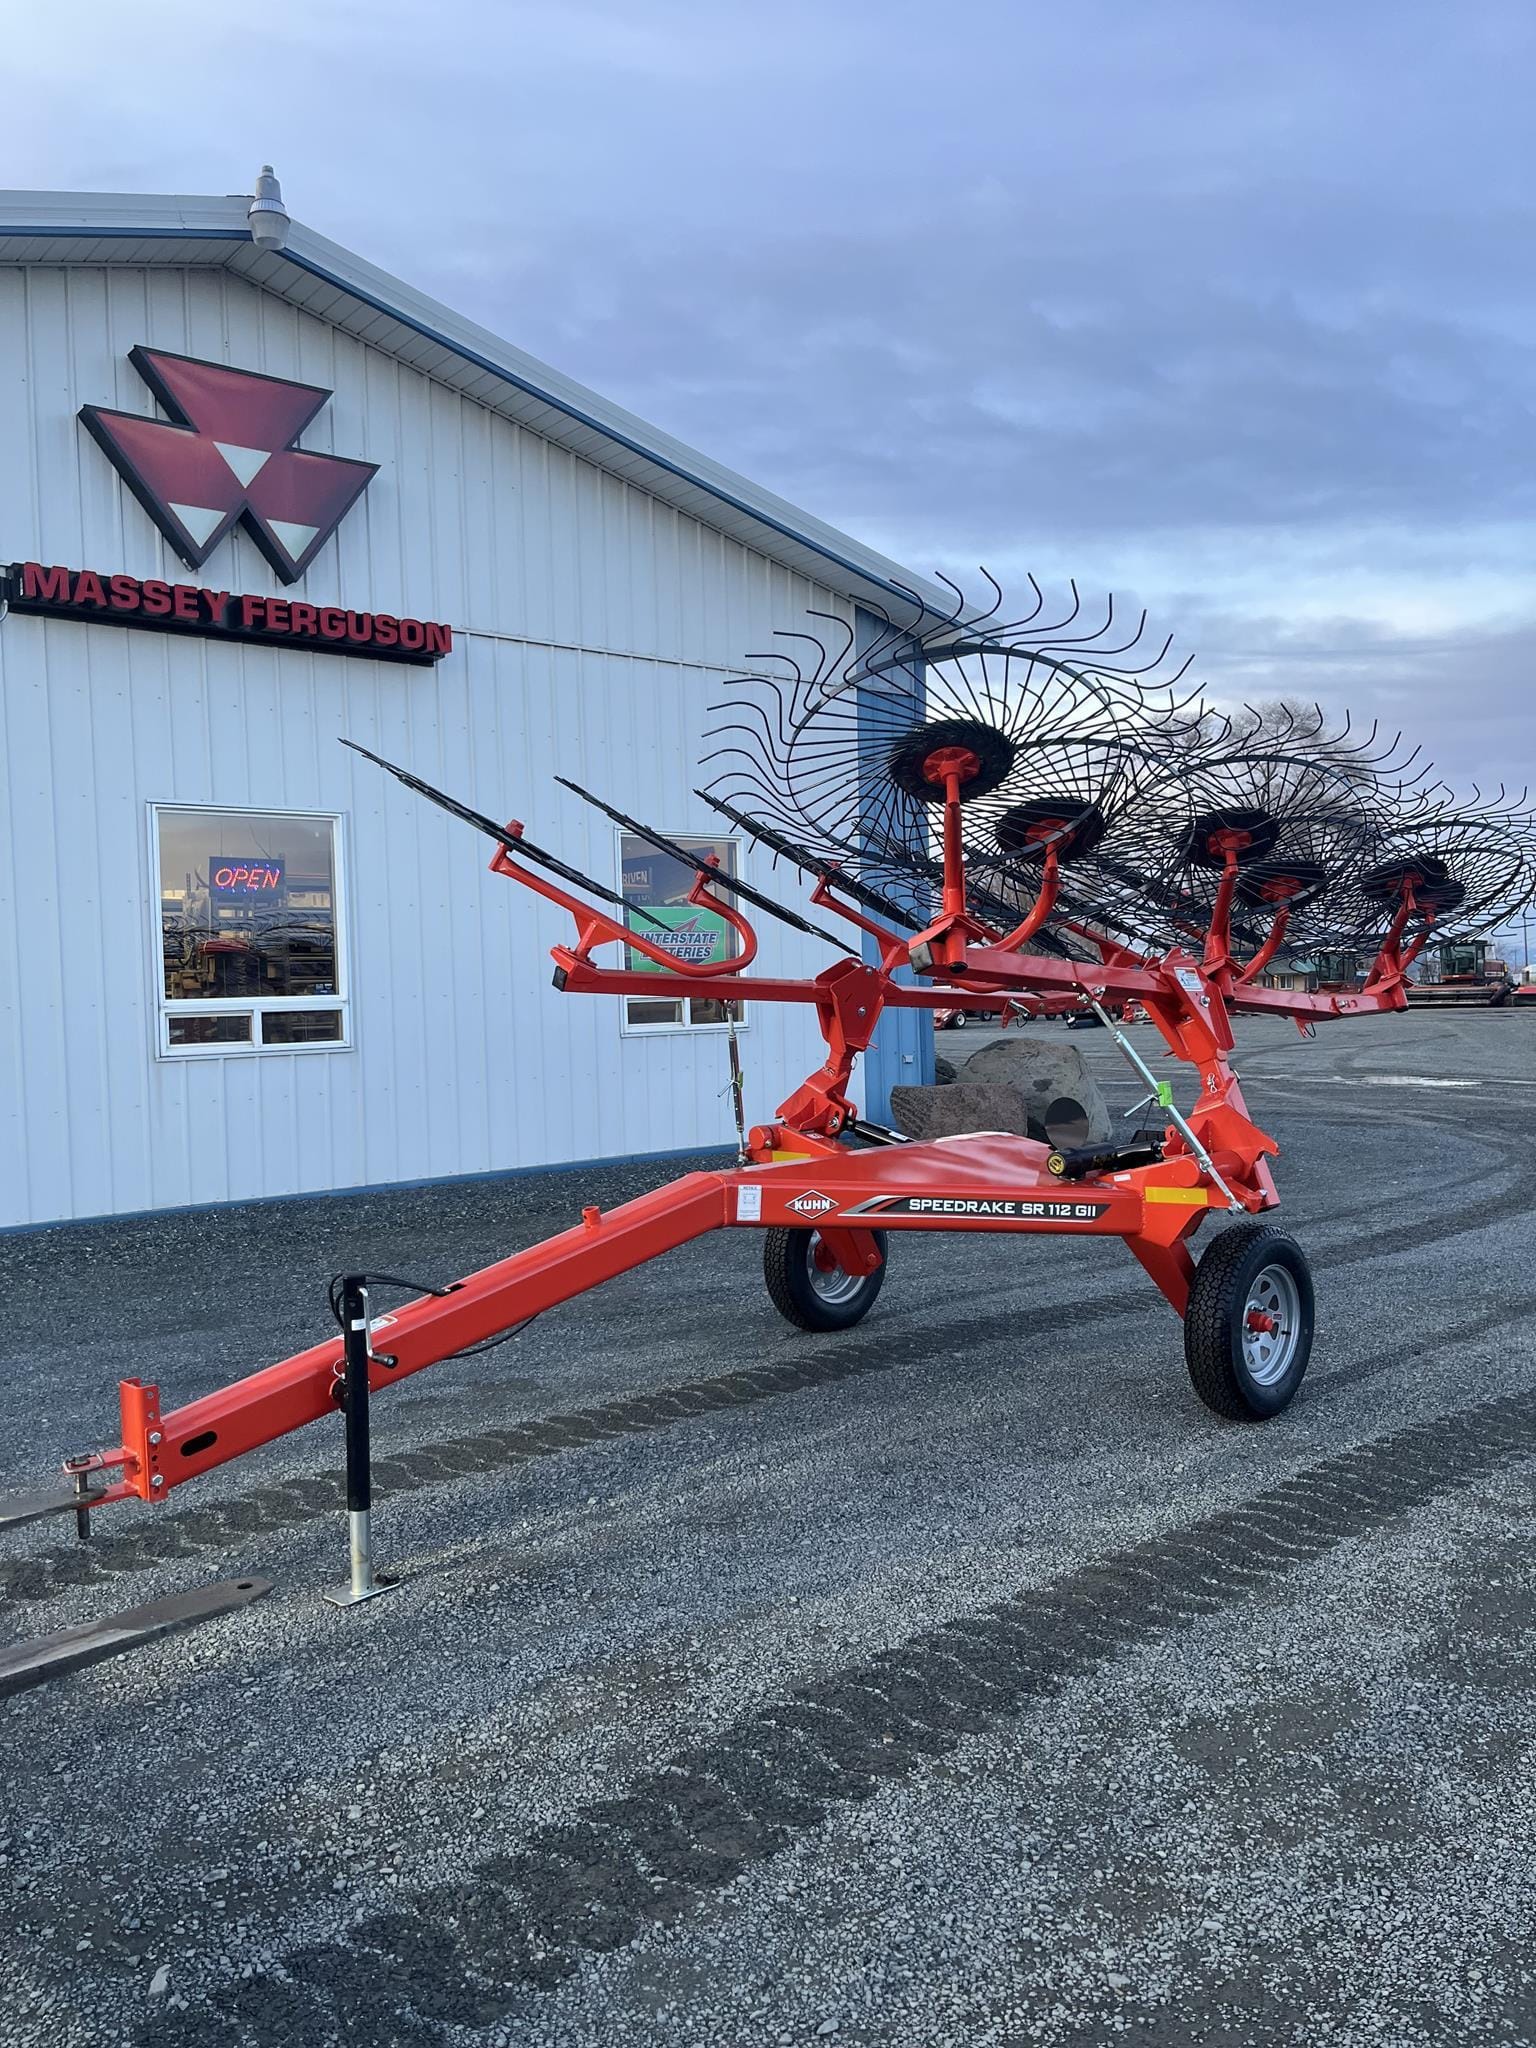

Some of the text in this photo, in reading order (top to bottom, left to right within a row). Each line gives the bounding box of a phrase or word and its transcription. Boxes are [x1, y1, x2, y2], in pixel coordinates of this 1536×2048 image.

[22, 561, 453, 654] MASSEY FERGUSON
[214, 867, 281, 889] OPEN
[642, 947, 712, 958] TERIES
[794, 1199, 831, 1211] KUHN
[909, 1198, 1096, 1217] SPEEDRAKE SR 112 GII
